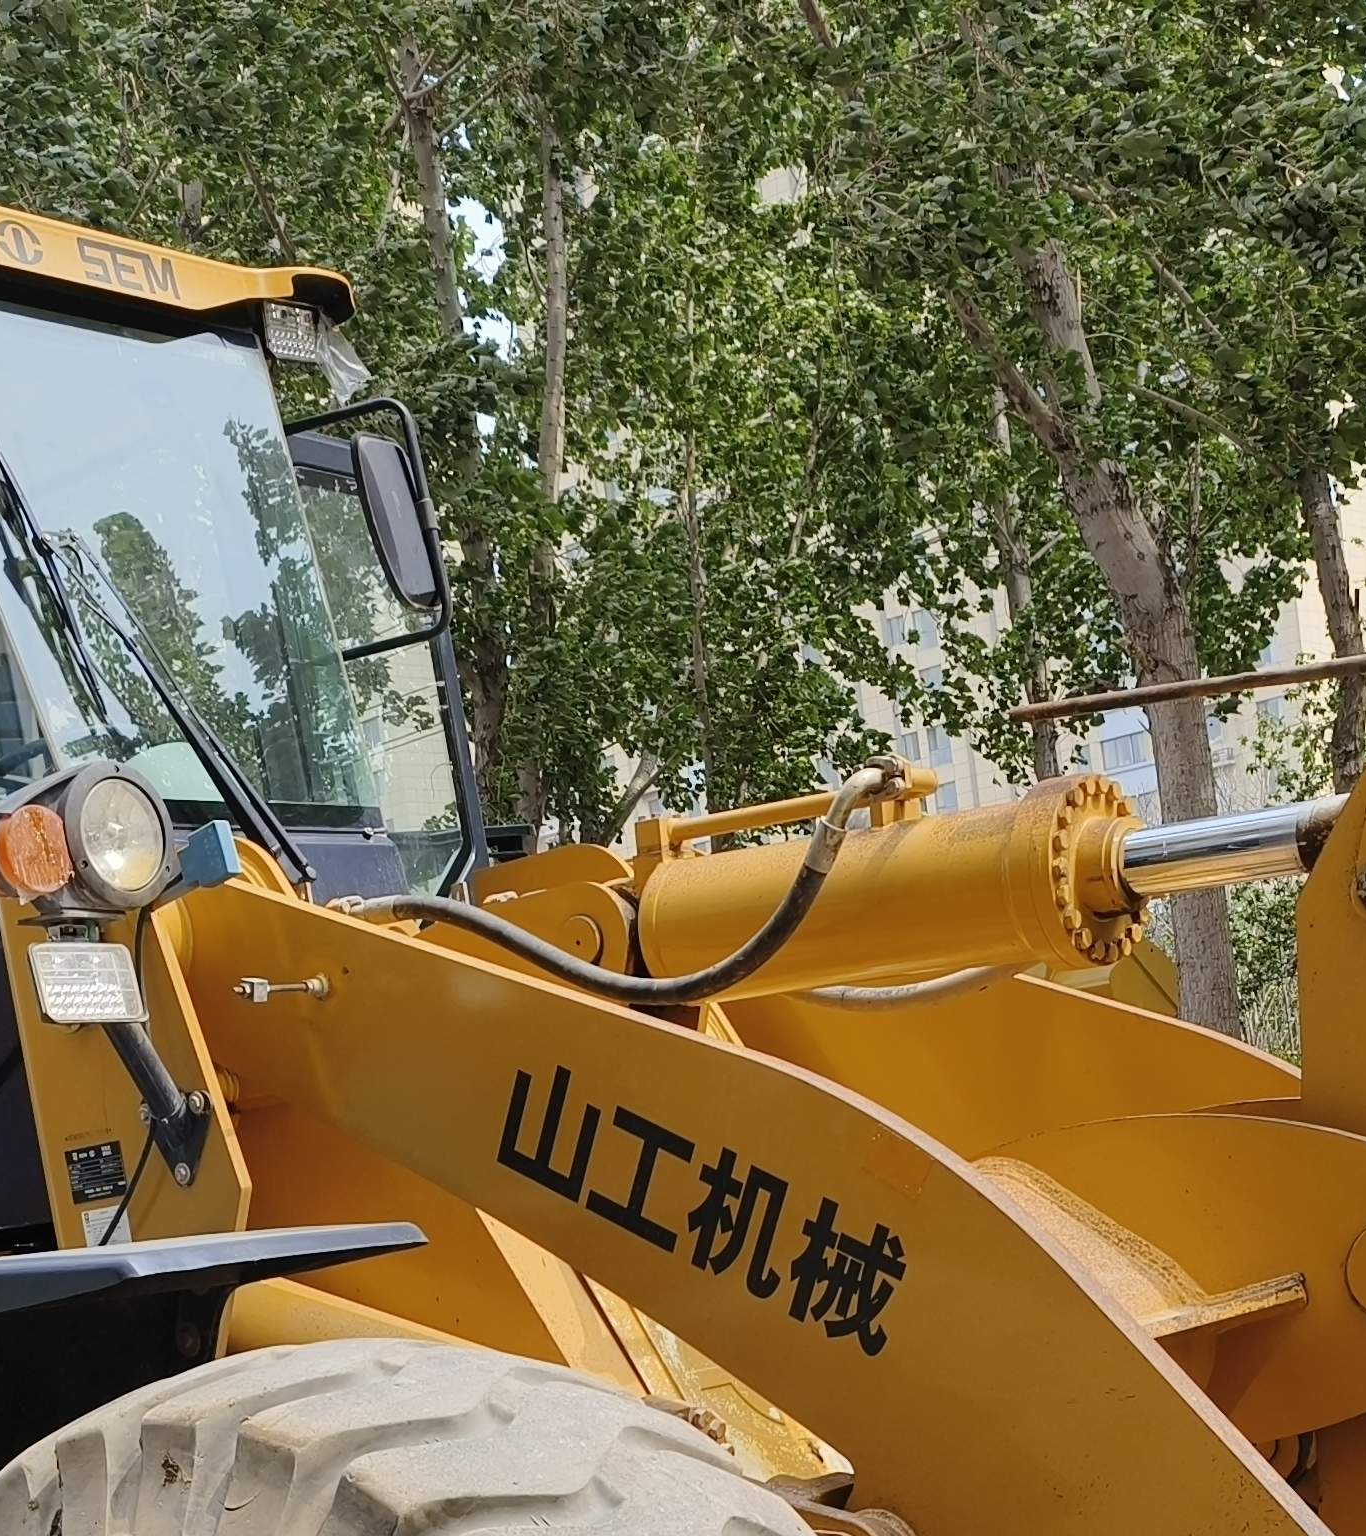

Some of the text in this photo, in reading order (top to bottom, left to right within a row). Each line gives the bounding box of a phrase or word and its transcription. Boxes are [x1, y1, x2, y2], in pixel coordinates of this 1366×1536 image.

[77, 237, 180, 300] SEM
[497, 1065, 907, 1357] 山工机械
